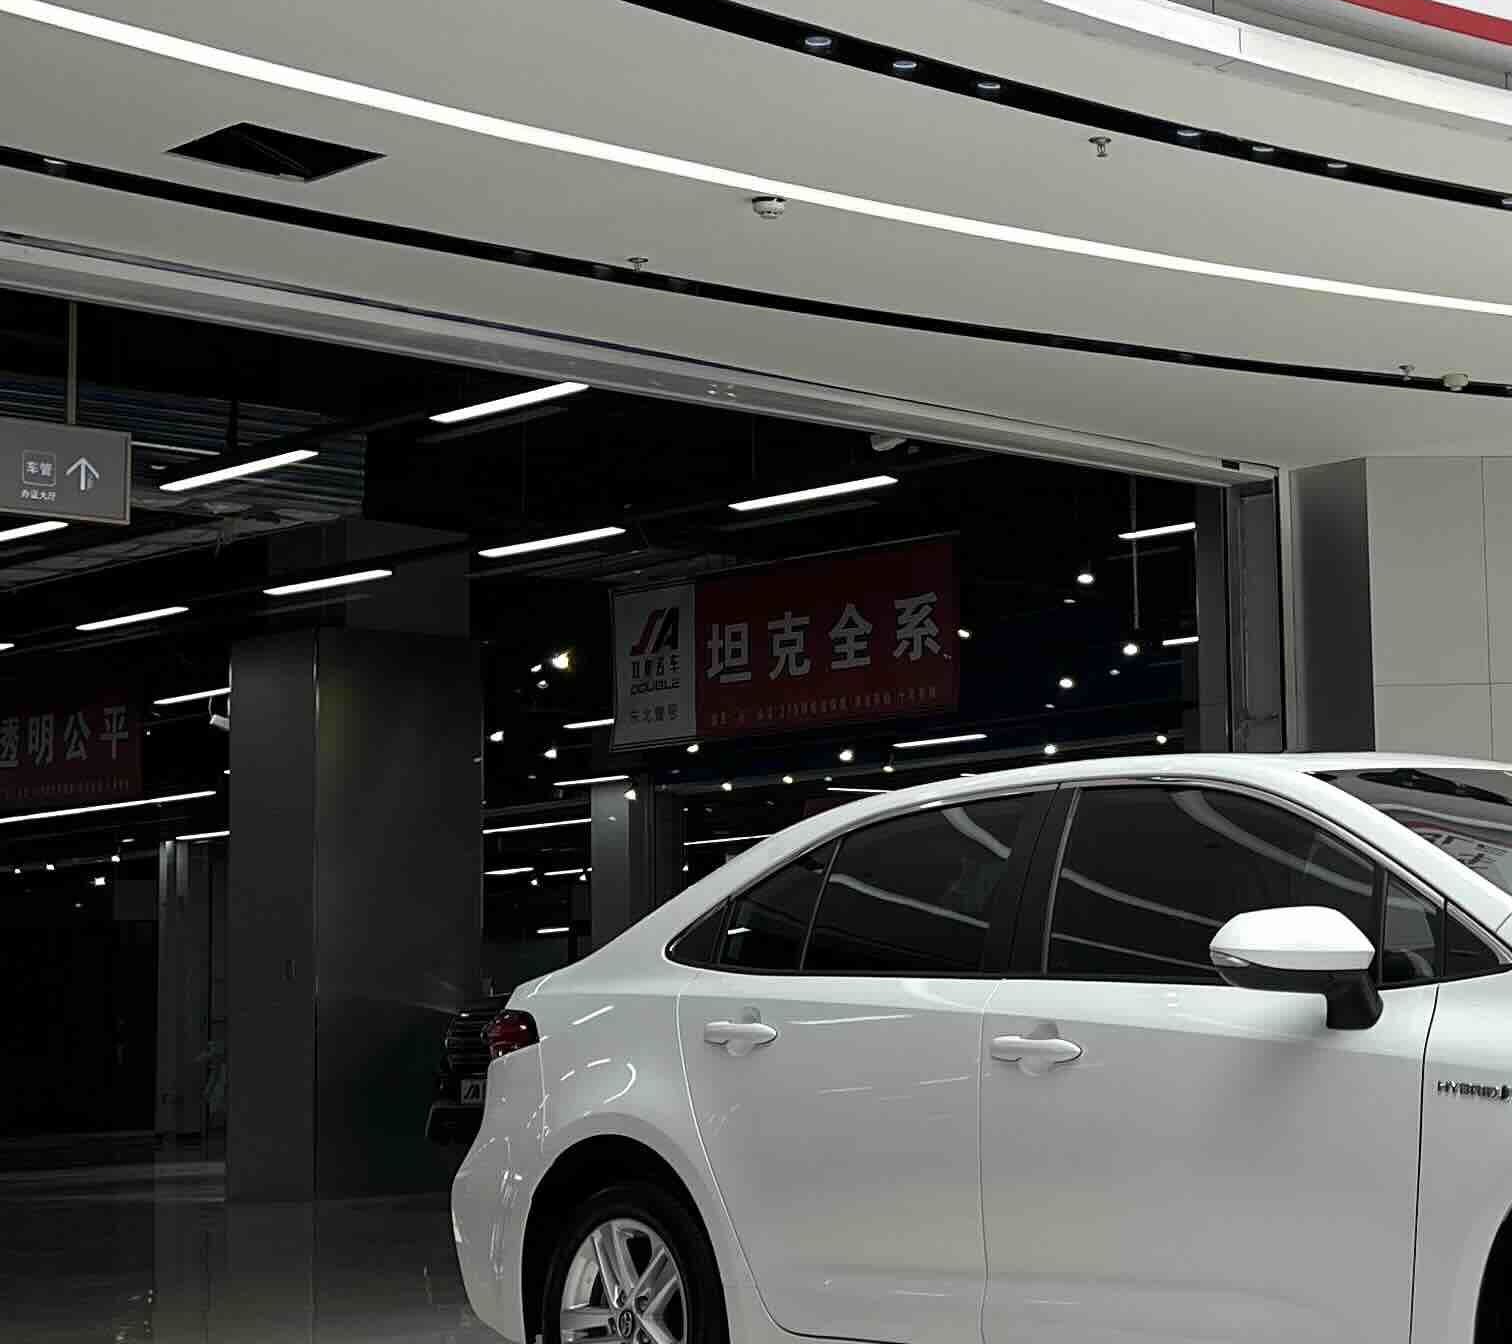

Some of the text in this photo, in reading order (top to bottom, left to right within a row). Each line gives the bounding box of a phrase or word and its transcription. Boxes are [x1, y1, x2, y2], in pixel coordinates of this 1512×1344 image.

[704, 591, 944, 684] 坦克全系
[1437, 1080, 1498, 1099] HYBRID
